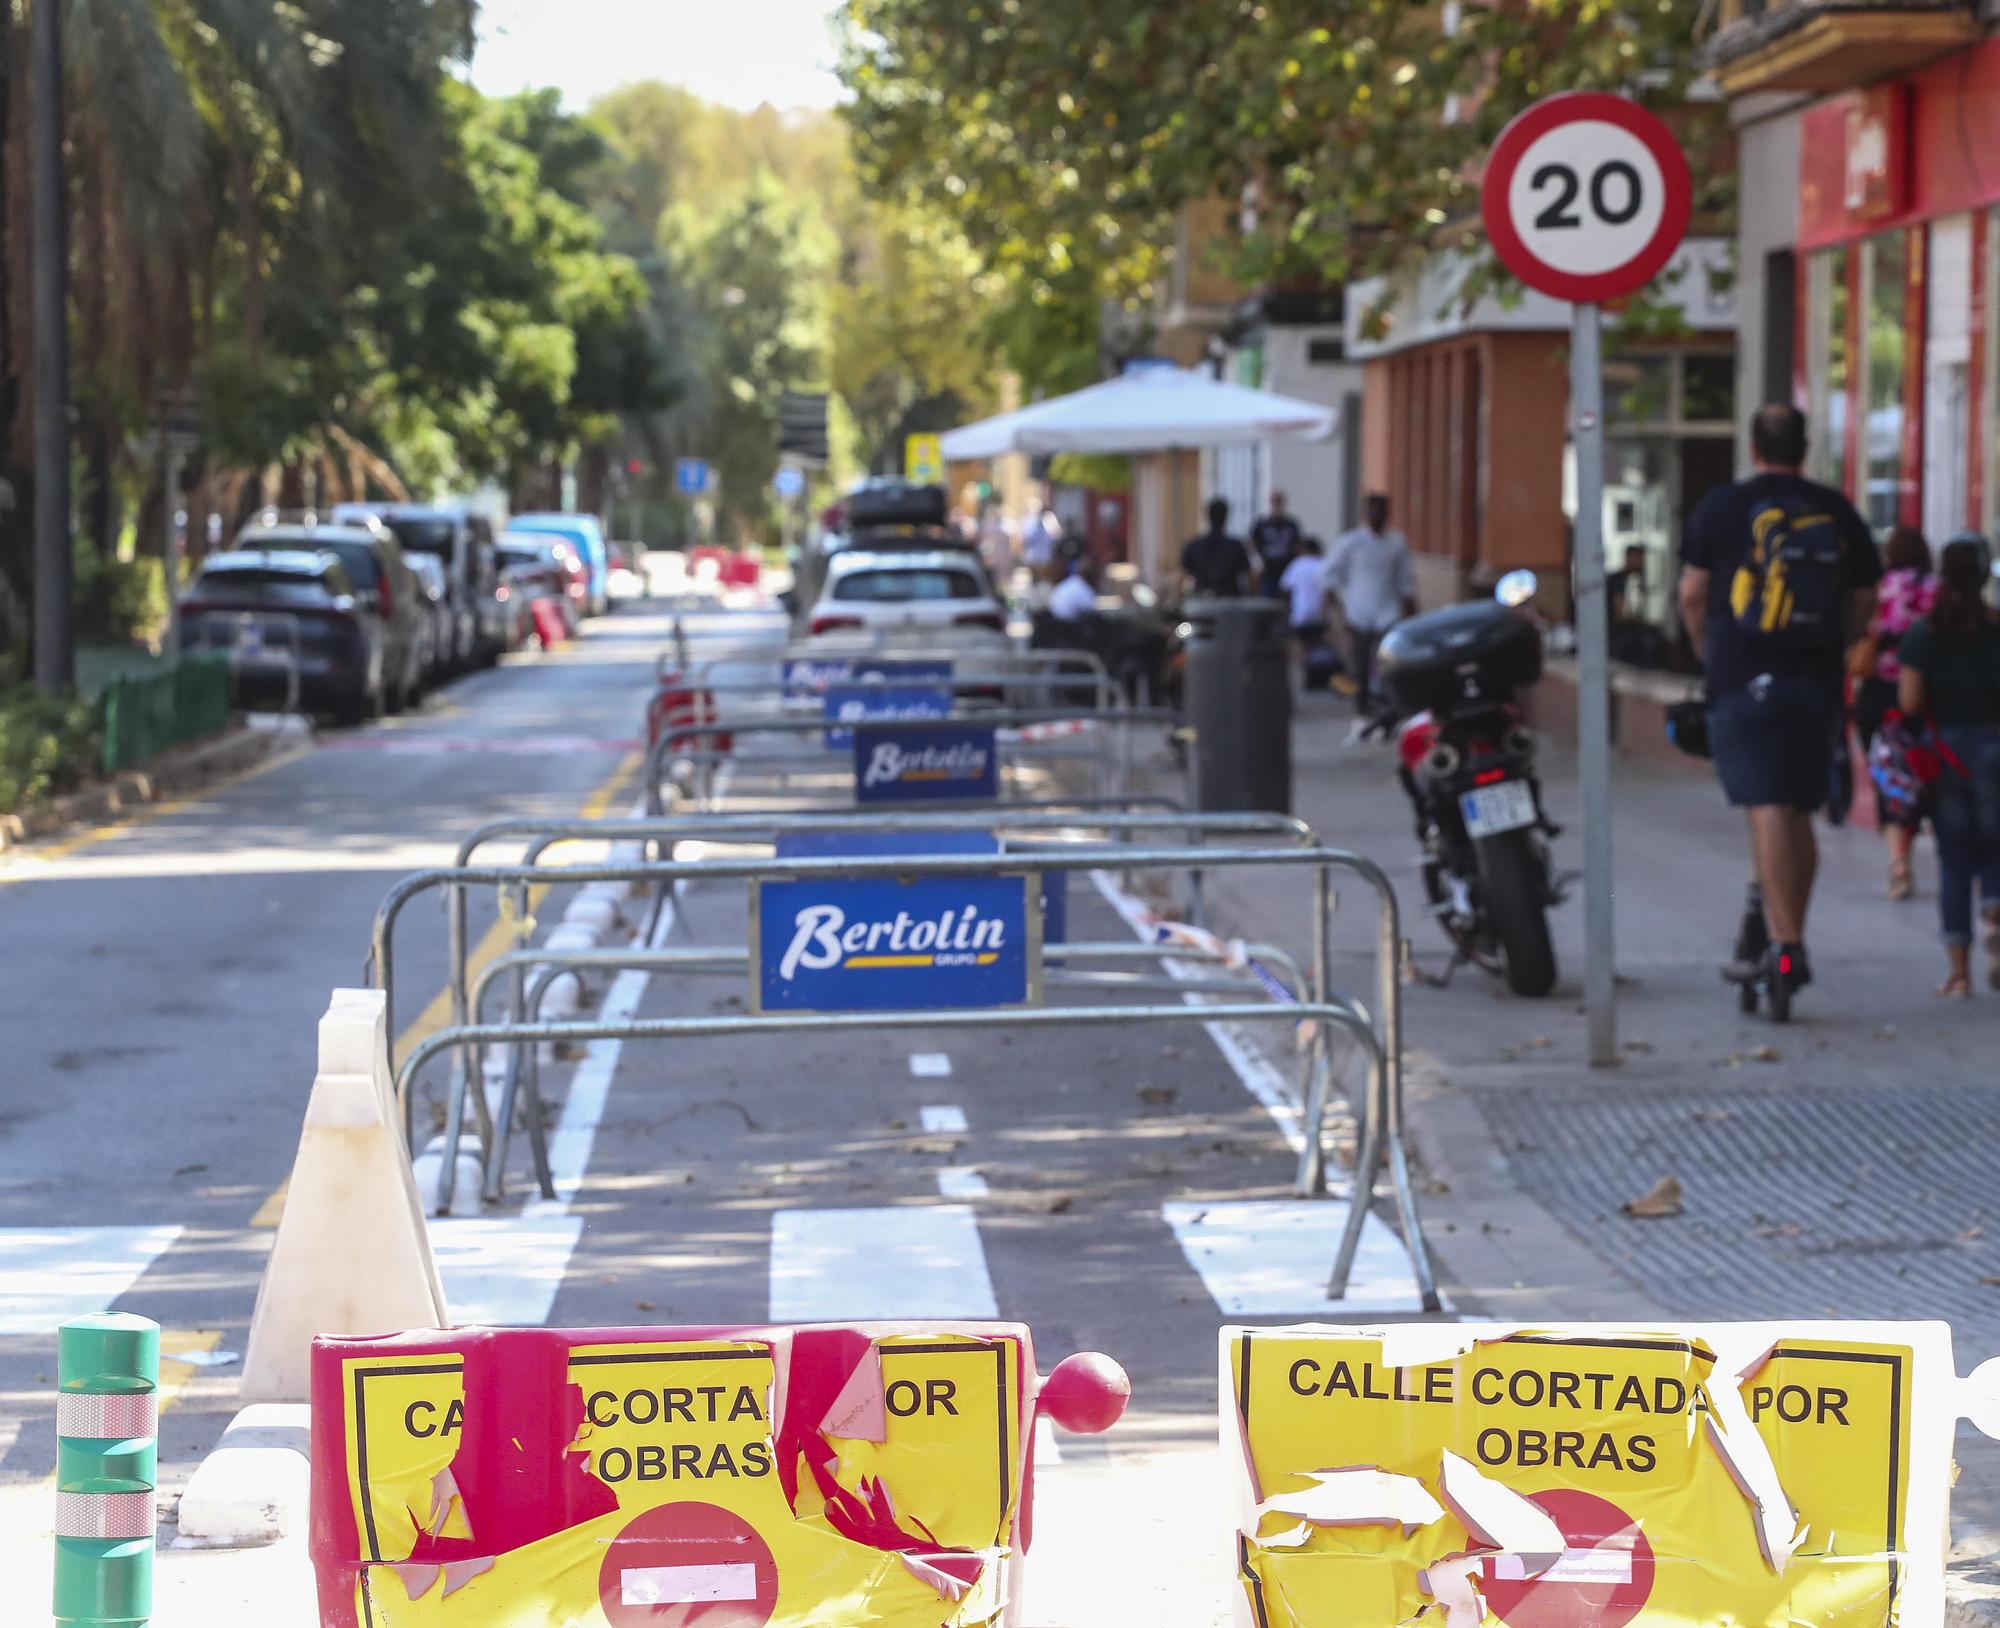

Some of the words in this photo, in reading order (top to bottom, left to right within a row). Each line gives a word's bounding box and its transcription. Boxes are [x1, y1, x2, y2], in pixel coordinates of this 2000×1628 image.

[1531, 160, 1642, 229] 20
[934, 952, 977, 967] GRUPO
[588, 1385, 771, 1428] CORTA
[885, 1379, 960, 1417] OR
[1288, 1358, 1454, 1403] CALLE
[1752, 1384, 1851, 1426] POR
[599, 1441, 771, 1483] OBRAS
[1476, 1427, 1657, 1474] OBRAS
